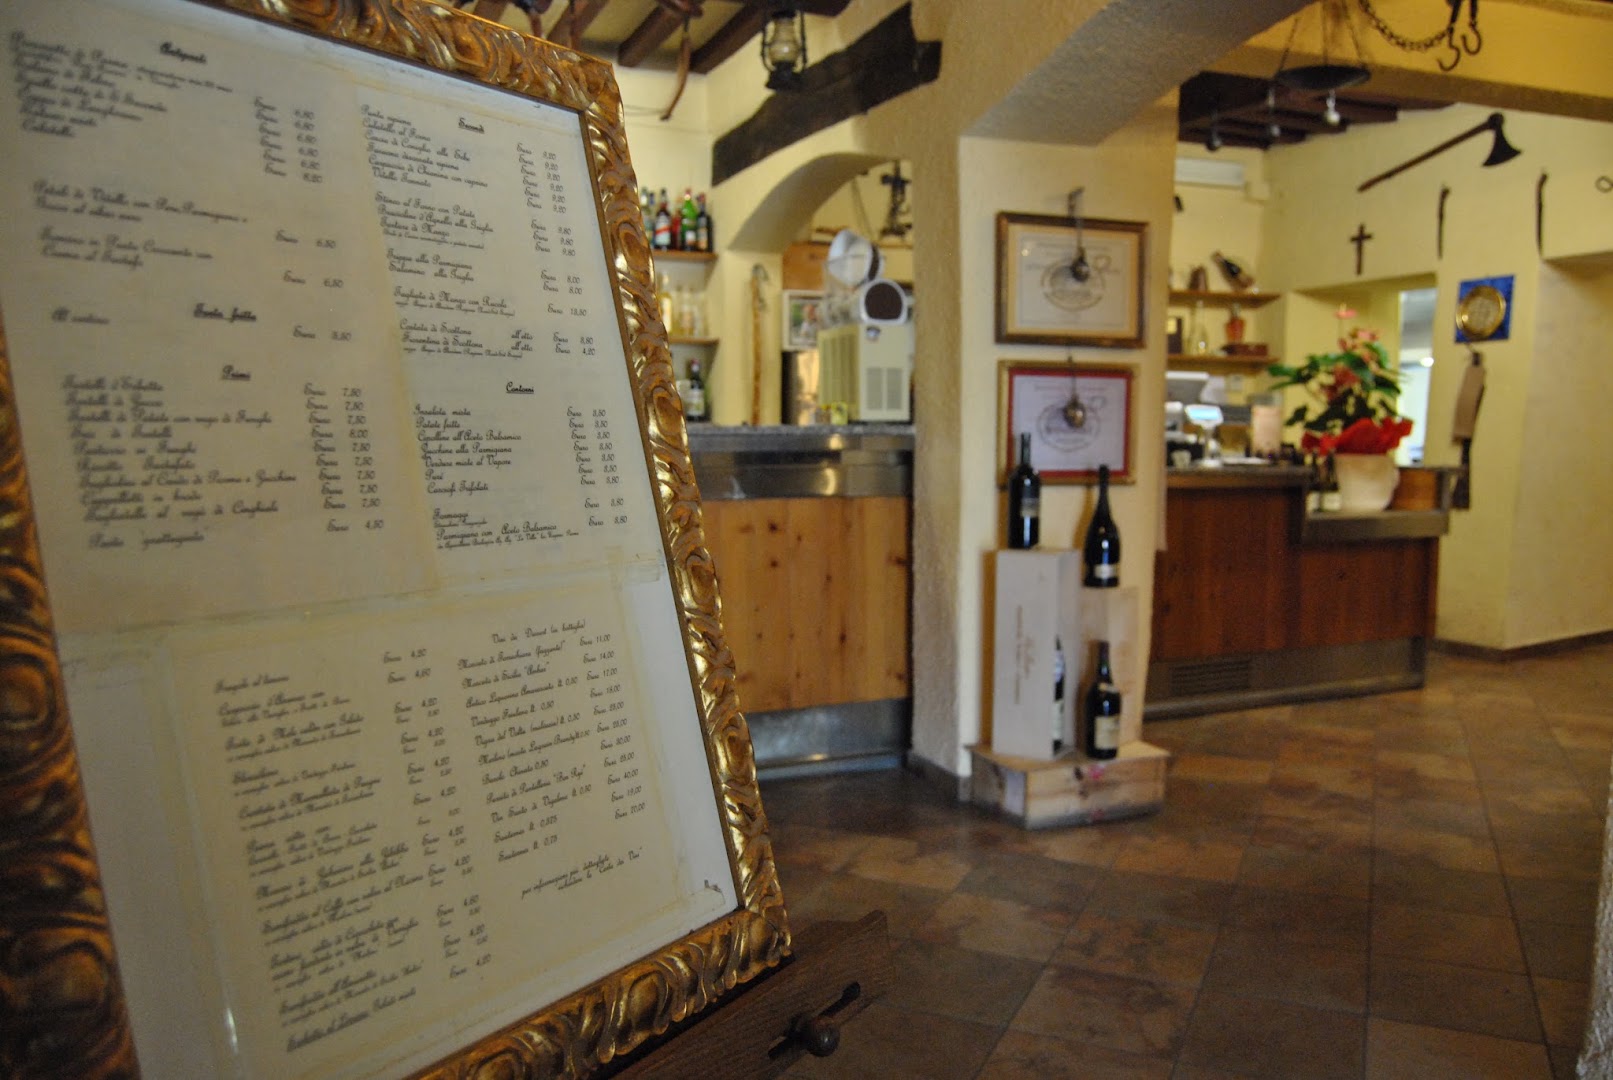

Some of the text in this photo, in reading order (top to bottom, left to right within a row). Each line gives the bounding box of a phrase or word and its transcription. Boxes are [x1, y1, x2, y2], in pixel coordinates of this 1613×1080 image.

[505, 381, 535, 394] Contorni
[566, 406, 582, 417] Euro
[568, 417, 585, 429] Euro
[570, 429, 587, 440] Euro
[472, 442, 512, 458] Parmigiana
[573, 440, 589, 452] Euro
[575, 452, 591, 463] Euro
[578, 463, 593, 474] Euro
[580, 474, 596, 486] Euro
[584, 498, 600, 509] Euro
[588, 515, 604, 527] Euro
